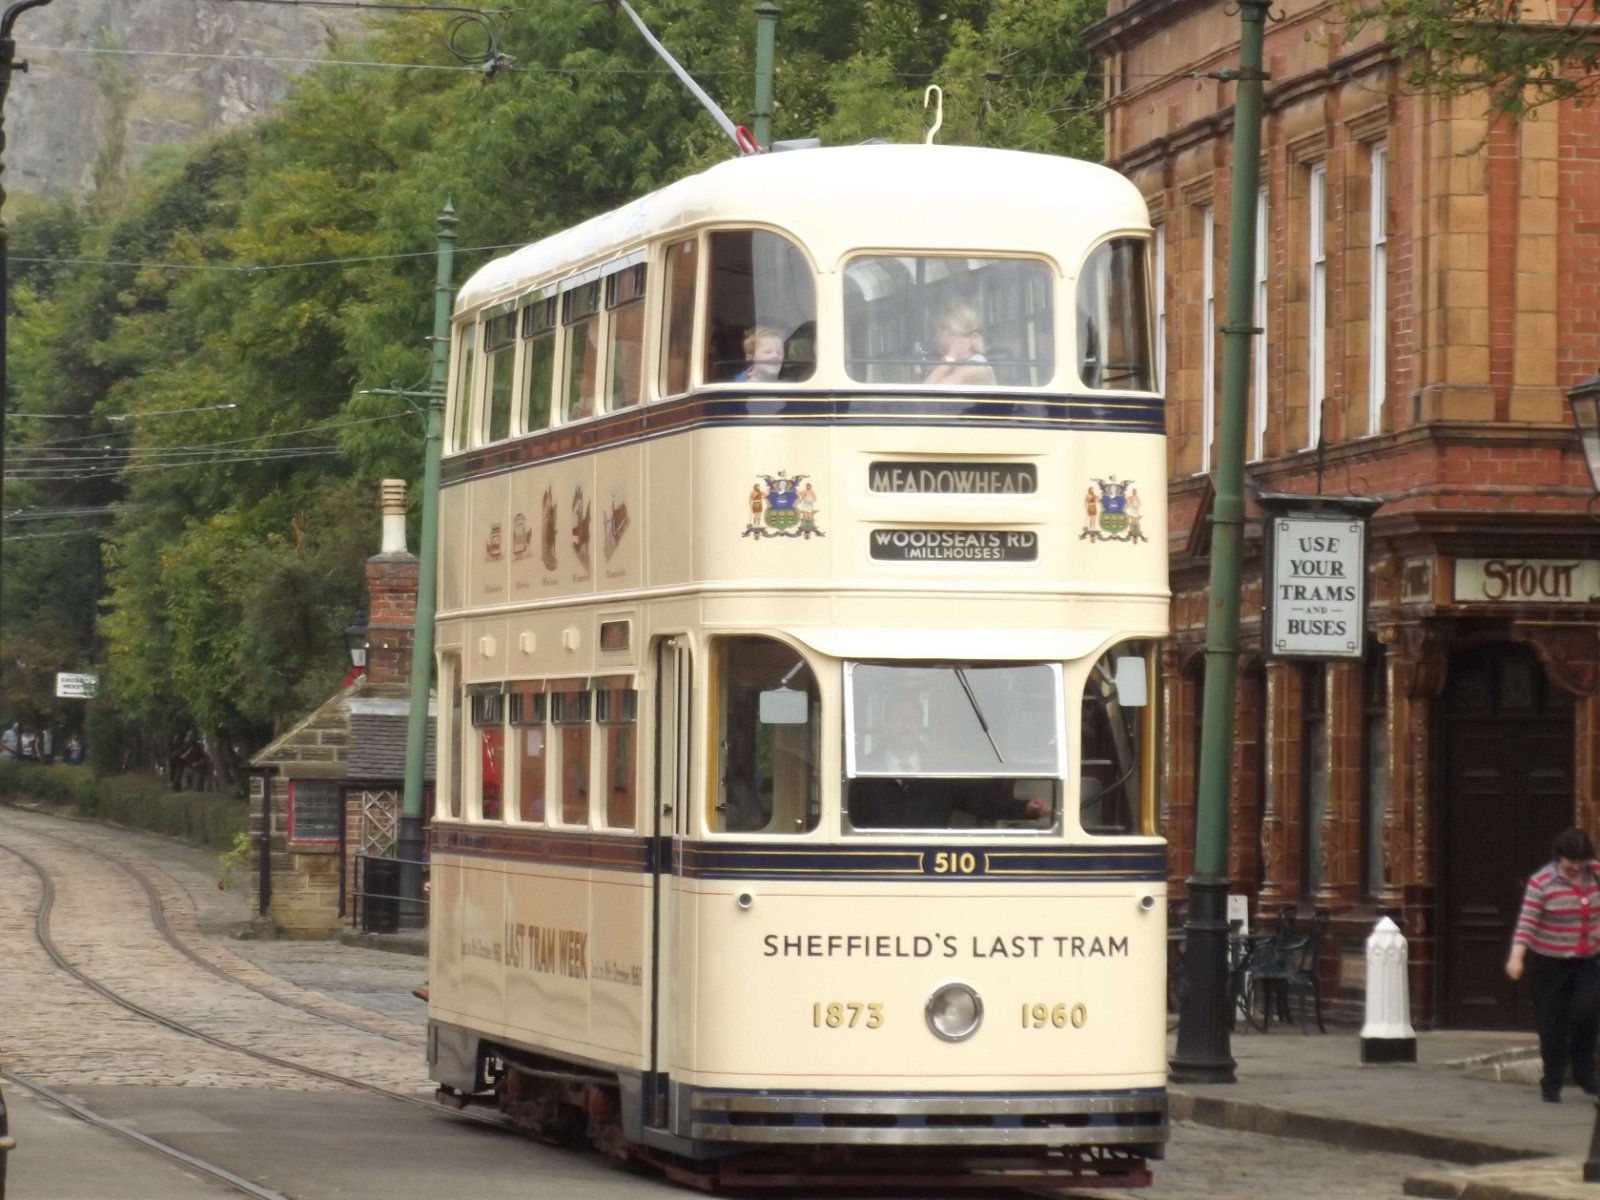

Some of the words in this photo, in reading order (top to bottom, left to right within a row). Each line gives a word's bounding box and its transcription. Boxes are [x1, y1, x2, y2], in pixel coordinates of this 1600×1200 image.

[873, 470, 1033, 493] MEADOWHEAD
[875, 531, 1001, 548] WOODSEATS
[1006, 533, 1035, 548] RD
[1298, 536, 1340, 554] USE
[1289, 559, 1345, 577] YOUR
[1279, 584, 1356, 602] TRAMS
[1305, 606, 1328, 615] AND
[1287, 619, 1346, 636] BUSES
[933, 852, 976, 874] 510
[505, 922, 526, 969] LAST
[529, 924, 556, 974] TRAM
[559, 928, 588, 980] WEEK
[763, 932, 959, 958] SHEFFIELD'S
[972, 935, 1044, 958] LAST
[1053, 935, 1130, 958] TRAM
[812, 1001, 885, 1030] 1873
[1021, 1001, 1088, 1030] 1960
